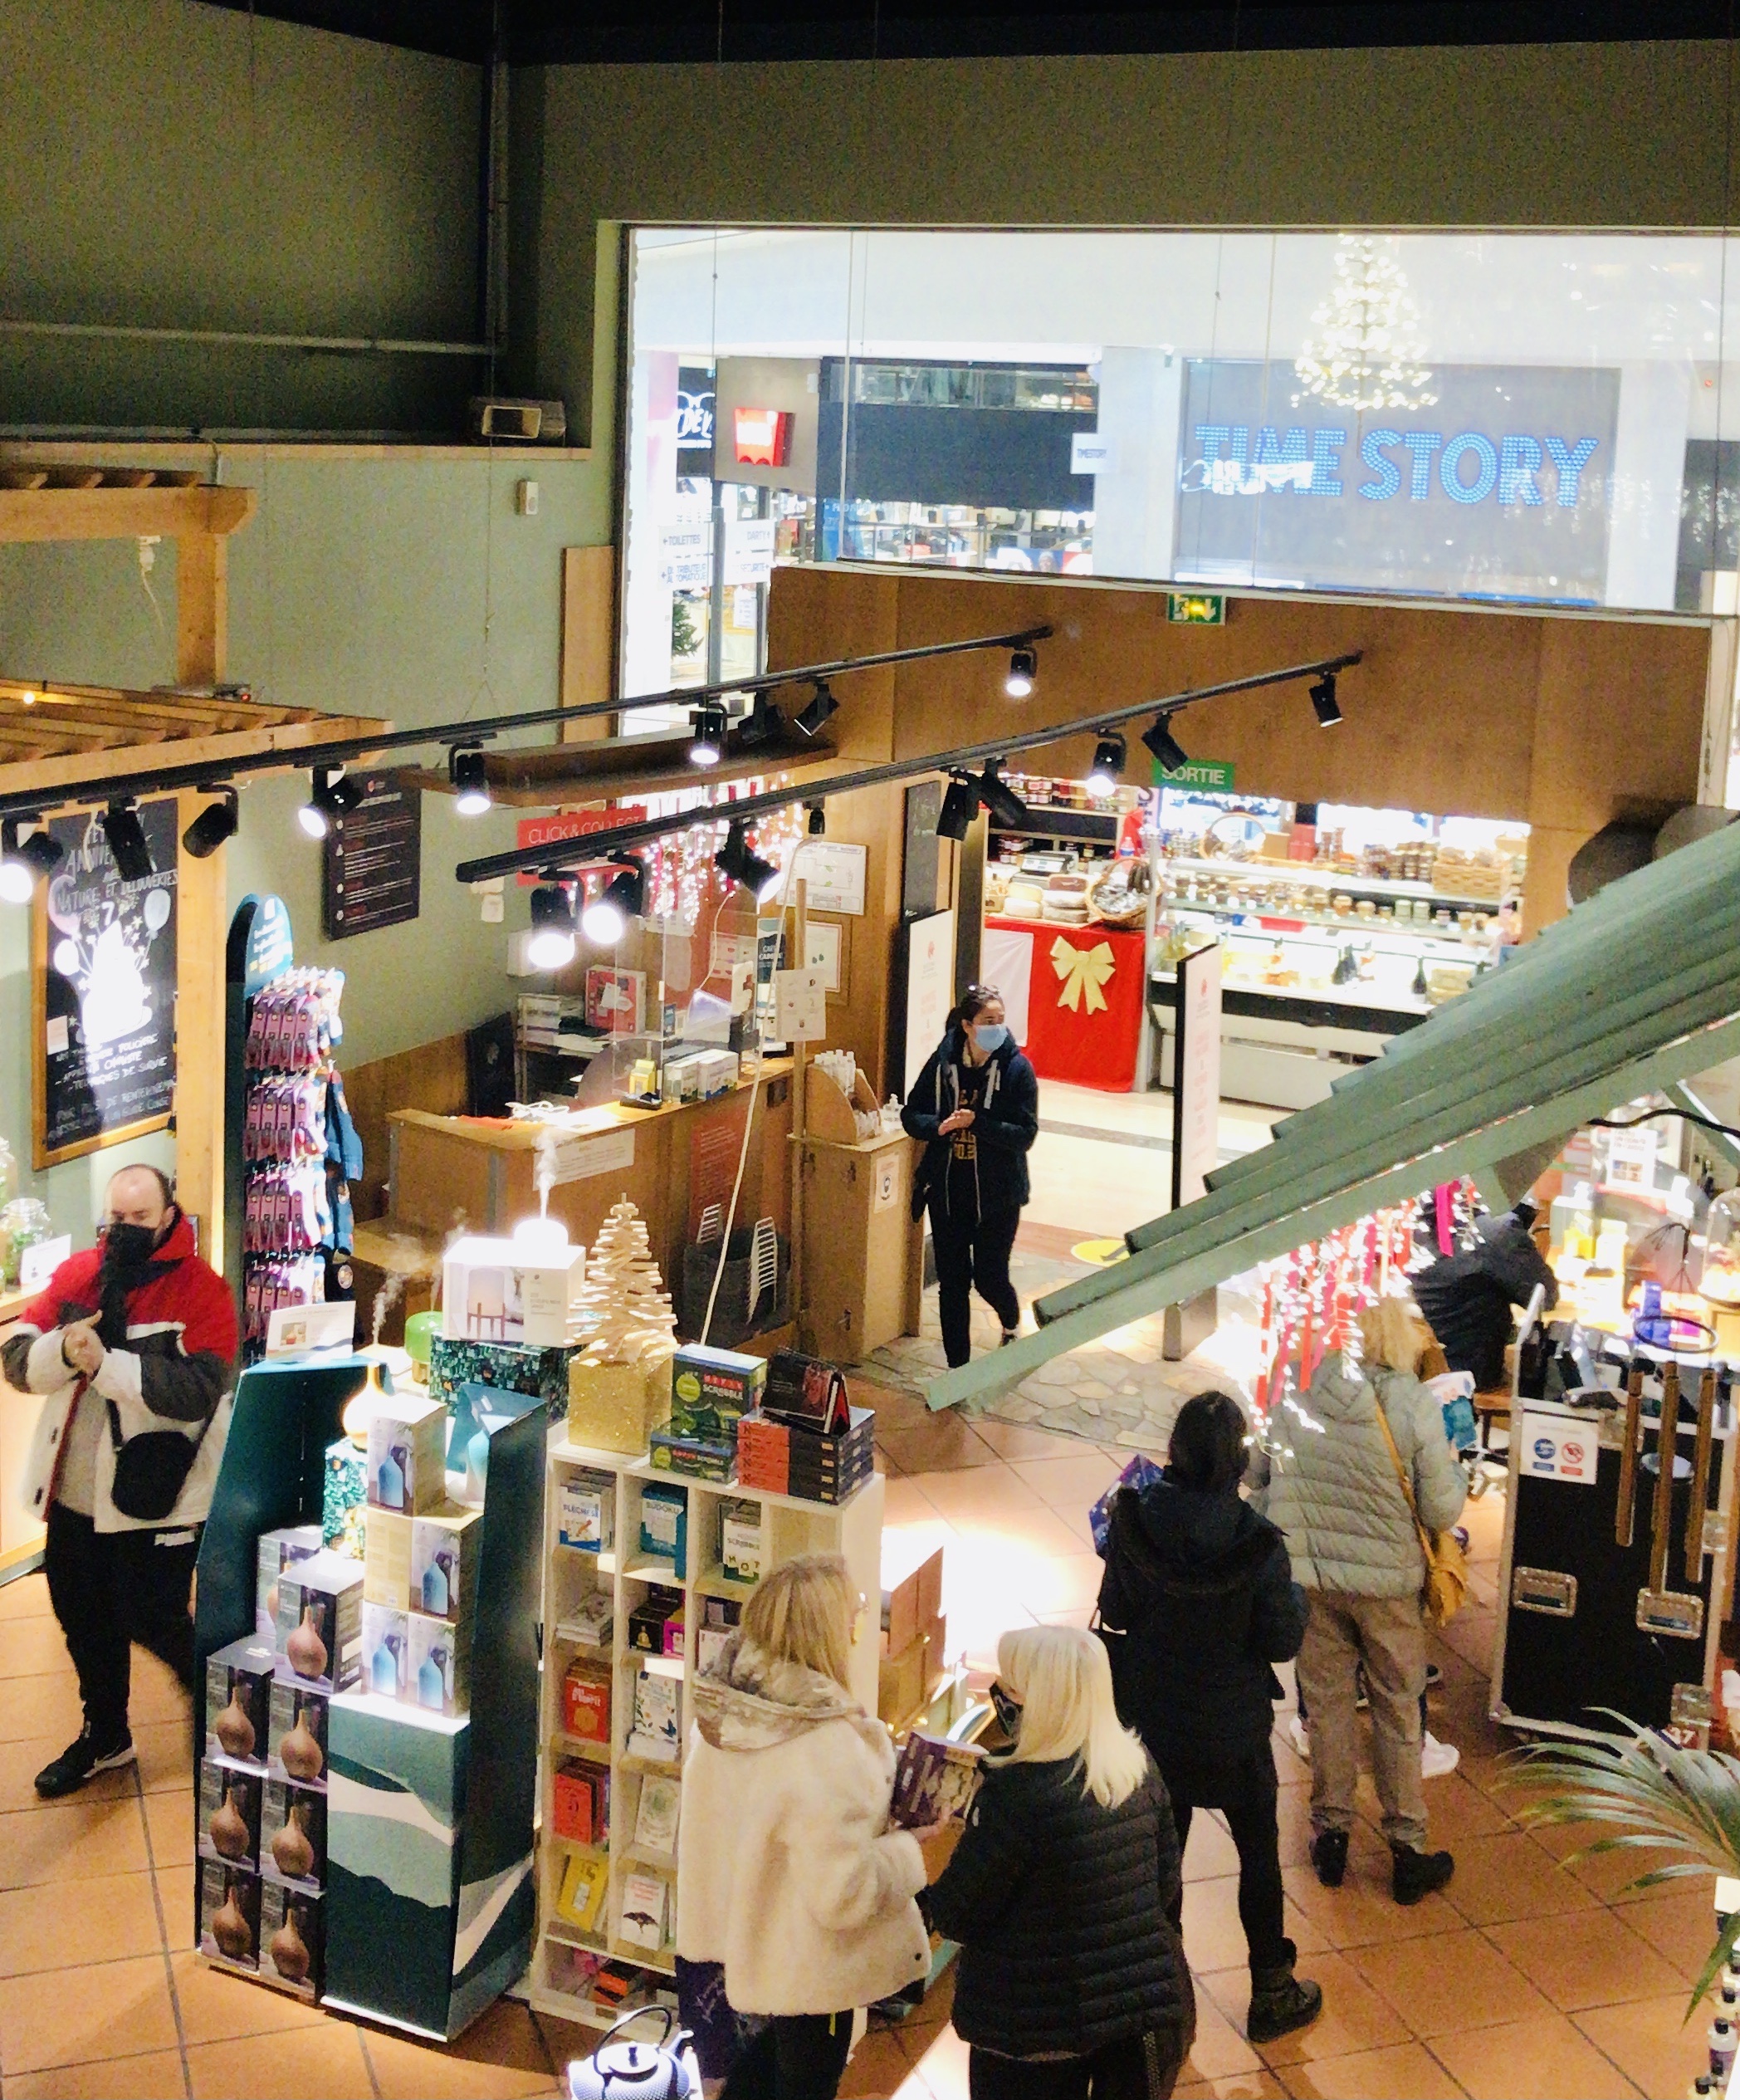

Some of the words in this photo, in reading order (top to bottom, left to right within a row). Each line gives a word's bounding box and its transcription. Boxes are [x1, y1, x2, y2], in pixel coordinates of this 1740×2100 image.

[1195, 425, 1347, 497] TIME
[1357, 428, 1599, 507] STORY
[1162, 766, 1225, 785] SORTIE
